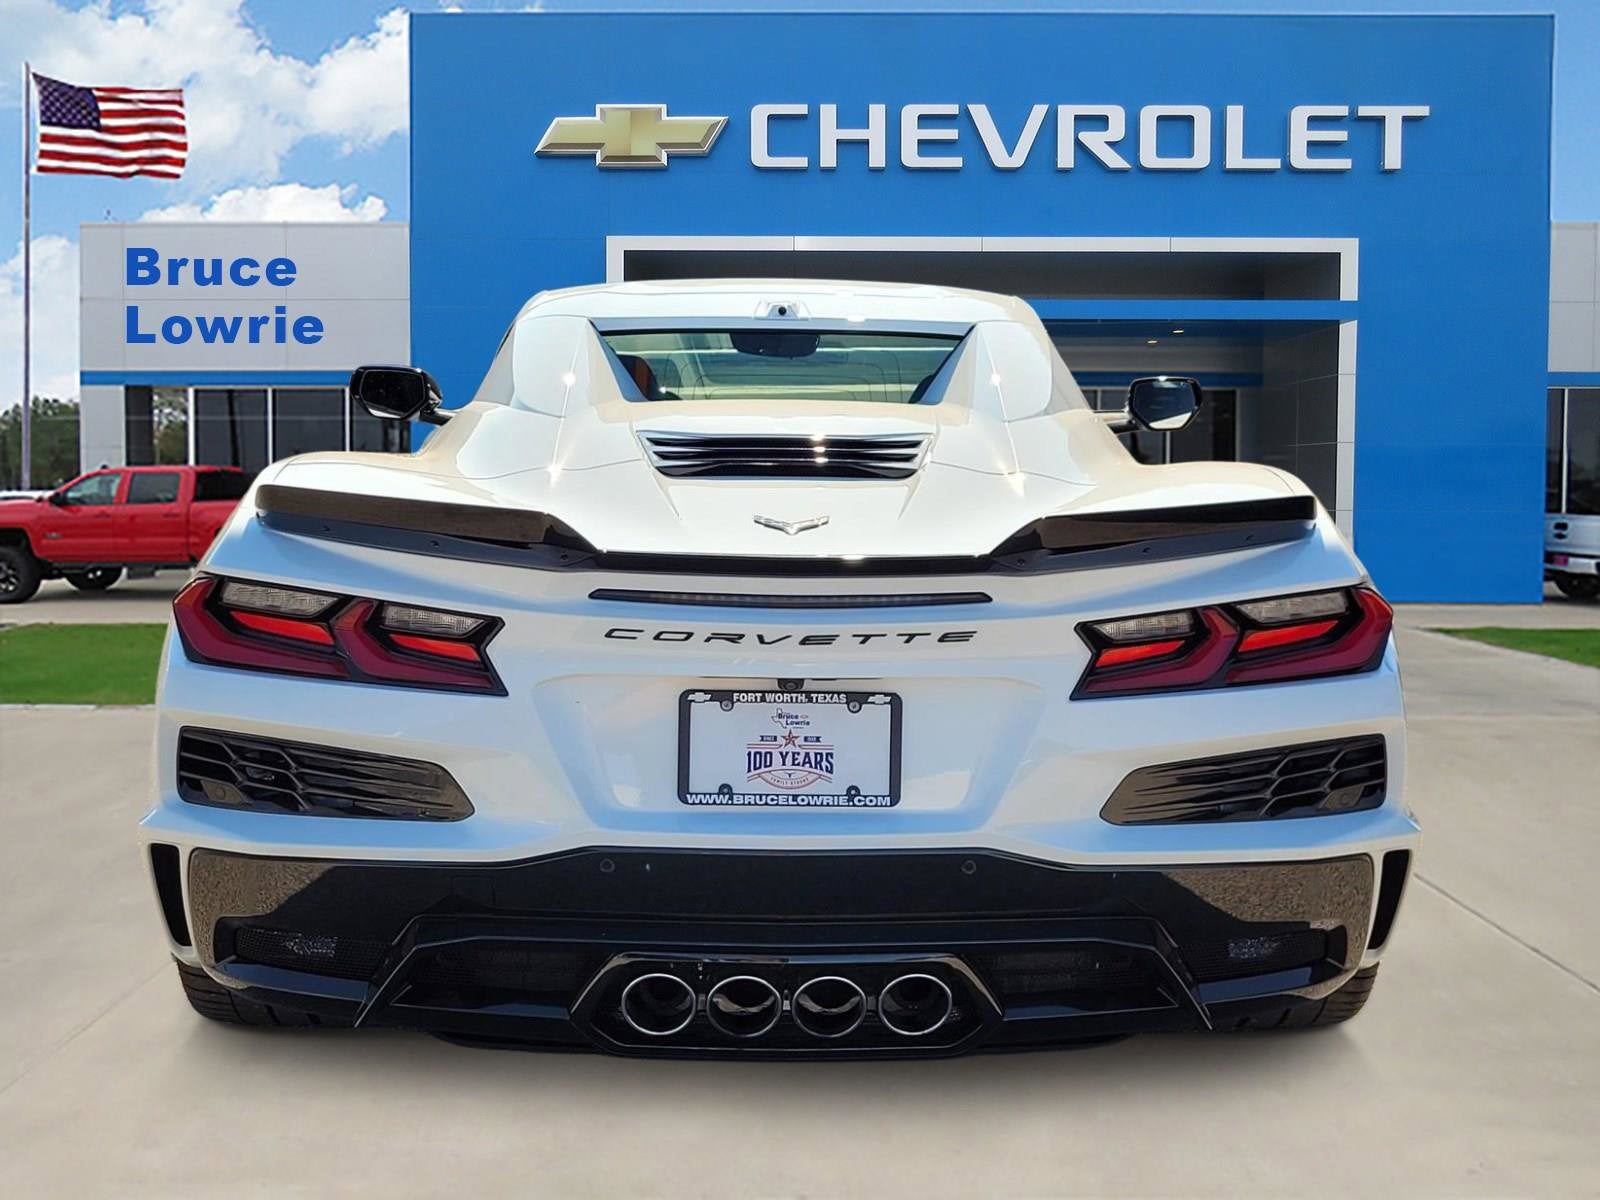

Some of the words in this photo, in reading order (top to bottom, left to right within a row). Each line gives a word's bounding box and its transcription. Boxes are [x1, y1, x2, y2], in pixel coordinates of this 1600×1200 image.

[750, 104, 1431, 171] CHEVROLET
[126, 247, 297, 287] Bruce
[126, 305, 324, 344] Lowrie
[604, 628, 978, 646] CORVETTE
[733, 692, 762, 703] FORT
[811, 693, 847, 704] TEXAS
[777, 712, 799, 720] Bruce
[746, 751, 773, 774] 100
[779, 751, 834, 775] YEARS
[686, 793, 891, 807] WWW.BRUCELOWRIE.COM
